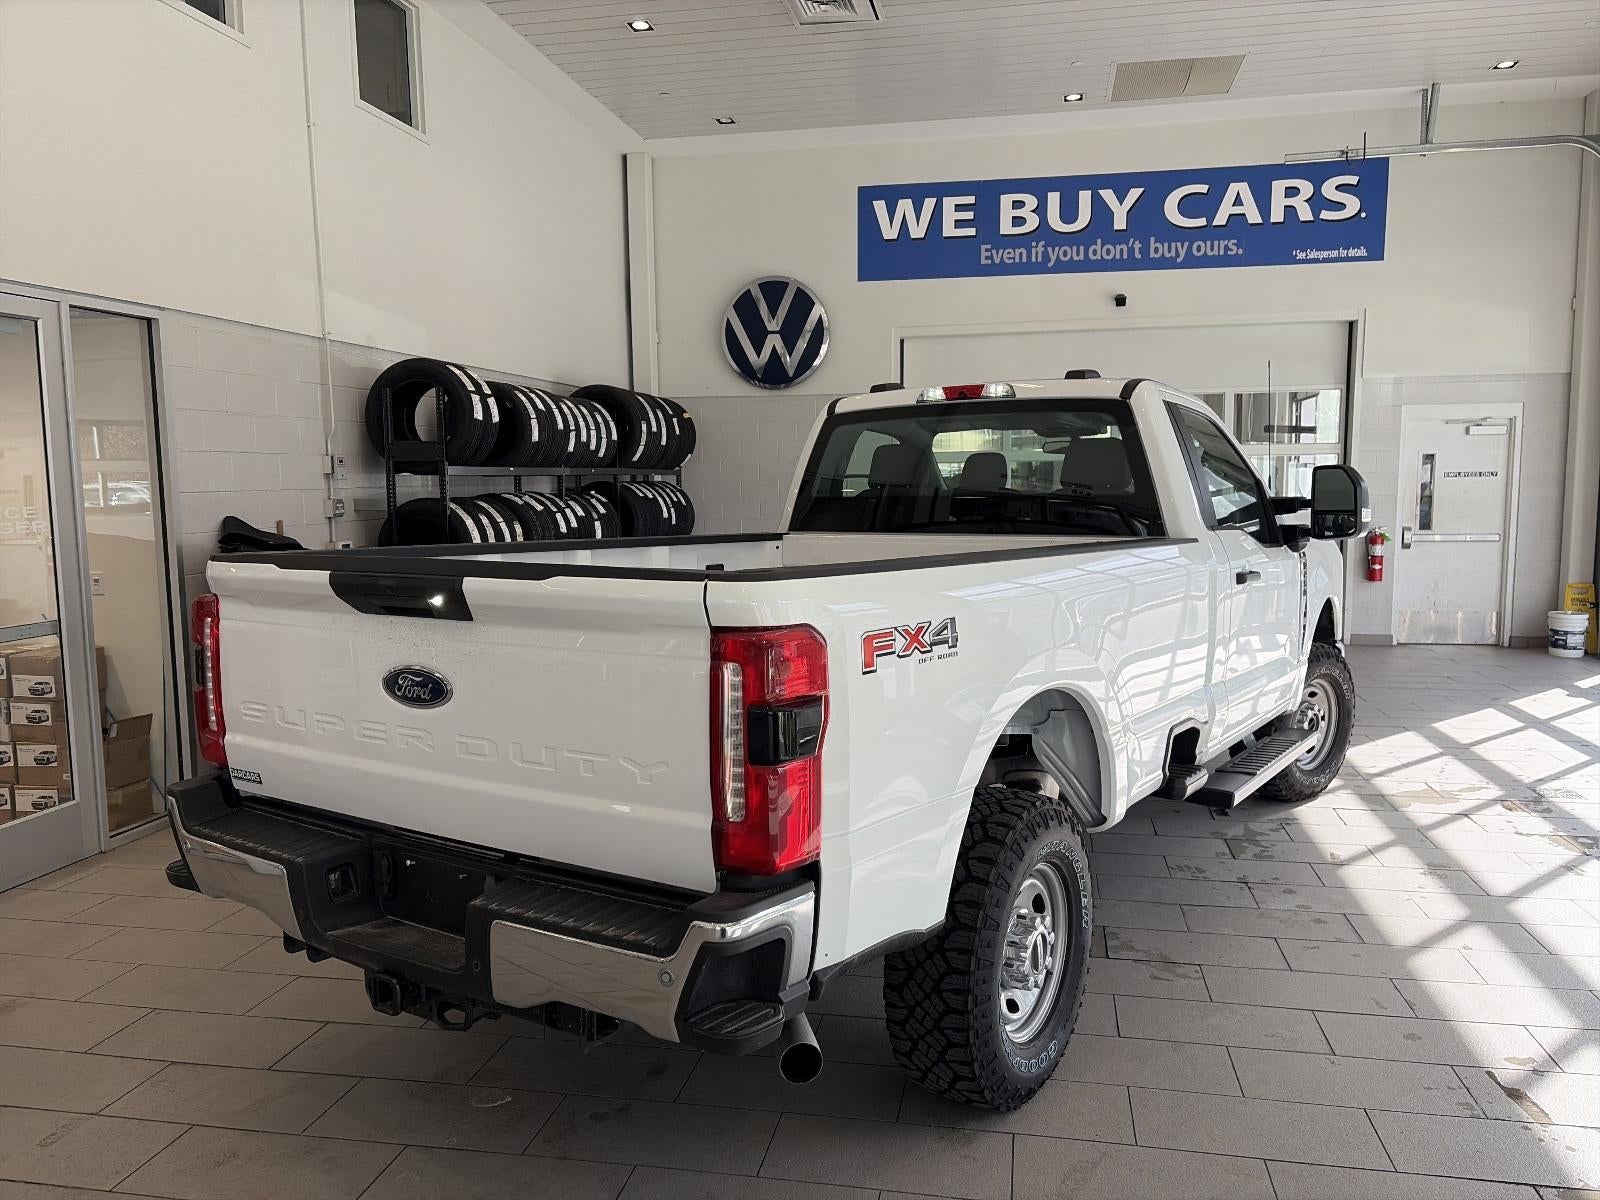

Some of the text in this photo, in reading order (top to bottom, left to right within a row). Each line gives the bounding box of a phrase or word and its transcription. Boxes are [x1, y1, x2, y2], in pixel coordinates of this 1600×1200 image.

[872, 175, 1367, 240] WE BUY CARS.
[980, 237, 1243, 268] Even if you don't buy ours.
[1307, 248, 1339, 261] Salesperson
[1339, 246, 1348, 258] for
[1348, 245, 1368, 257] details.
[861, 617, 958, 675] FX4
[918, 651, 959, 665] OFF ROAD
[394, 672, 433, 701] Ford
[239, 700, 670, 785] SUPER DUTY
[230, 768, 261, 782] DARCARS
